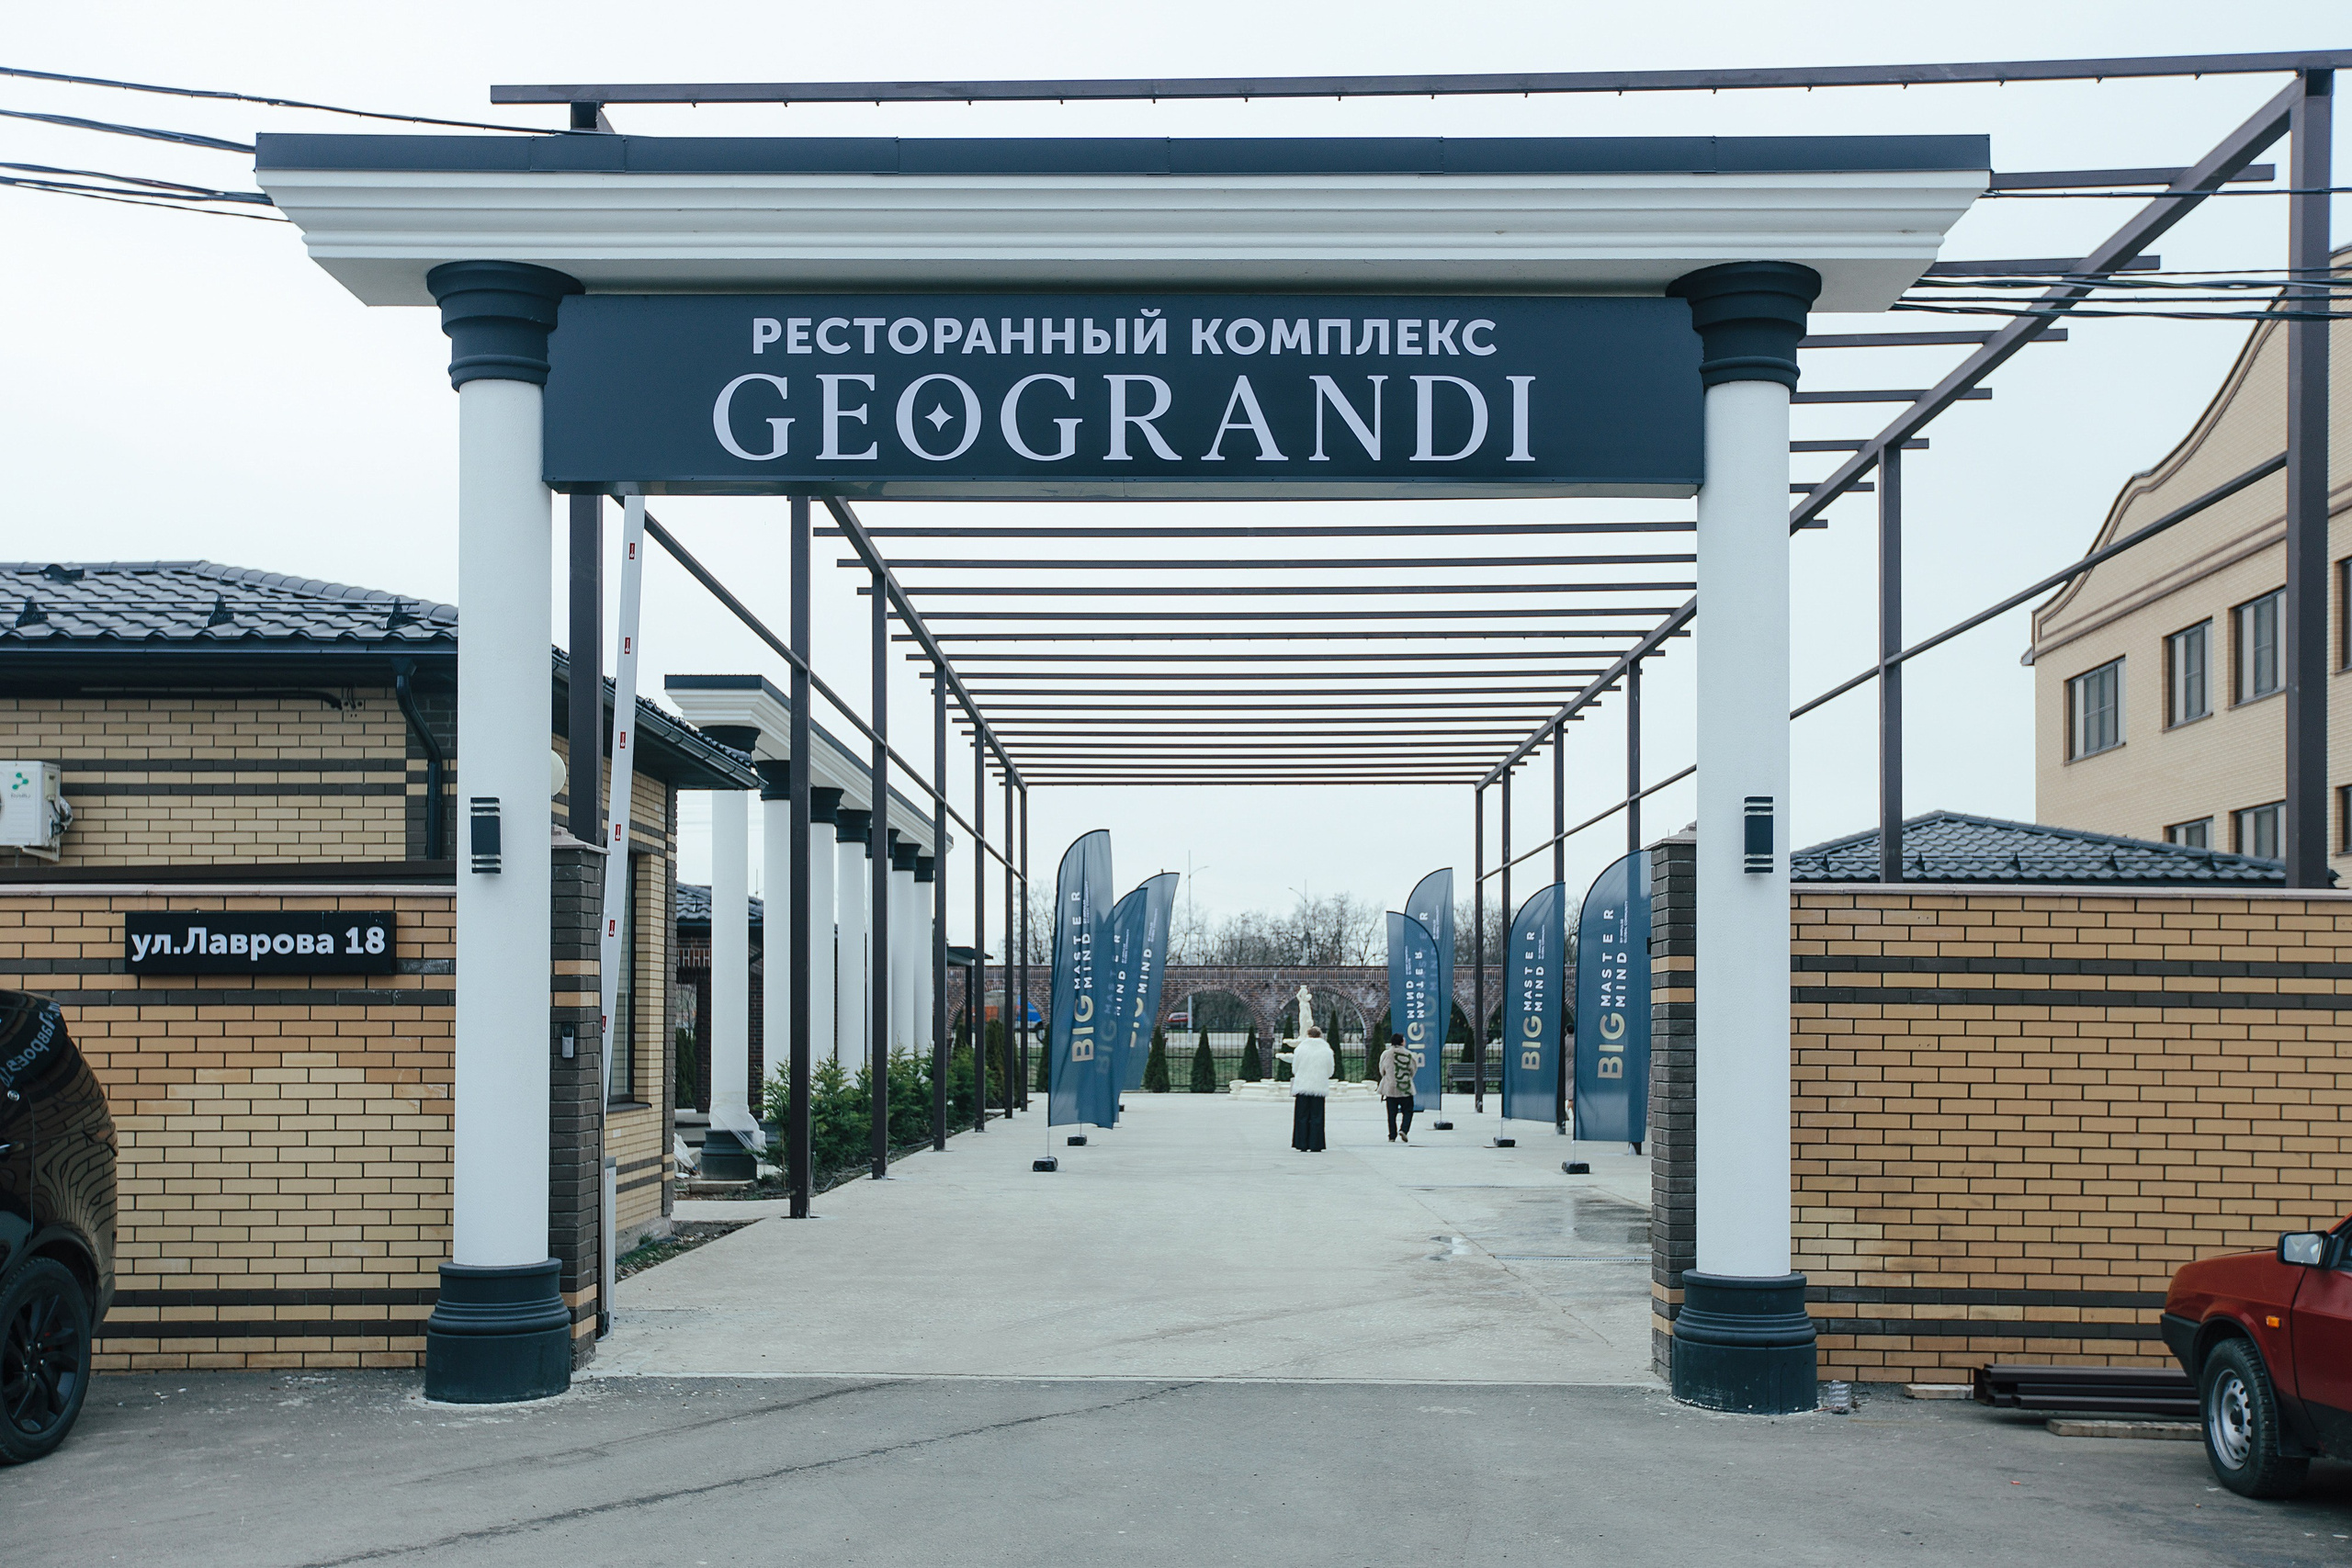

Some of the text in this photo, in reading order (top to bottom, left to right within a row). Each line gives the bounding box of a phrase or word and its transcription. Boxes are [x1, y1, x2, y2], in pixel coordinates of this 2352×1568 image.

[752, 308, 1498, 356] РЕСТОРАННЫЙ КОМПЛЕКС
[712, 373, 1536, 462] GEOGRANDI
[131, 926, 386, 962] ул.Лаврова 18
[1071, 891, 1081, 990] MASTER
[1082, 932, 1092, 989] MIND
[1600, 908, 1613, 1008] MASTER
[1136, 948, 1152, 994] MIND
[1523, 931, 1535, 1011] MASTER
[1535, 965, 1544, 1012] MIND
[1615, 952, 1627, 1008] MIND
[1071, 995, 1094, 1063] BIG
[1521, 1015, 1543, 1071] BIG
[1597, 1011, 1625, 1079] BIG
